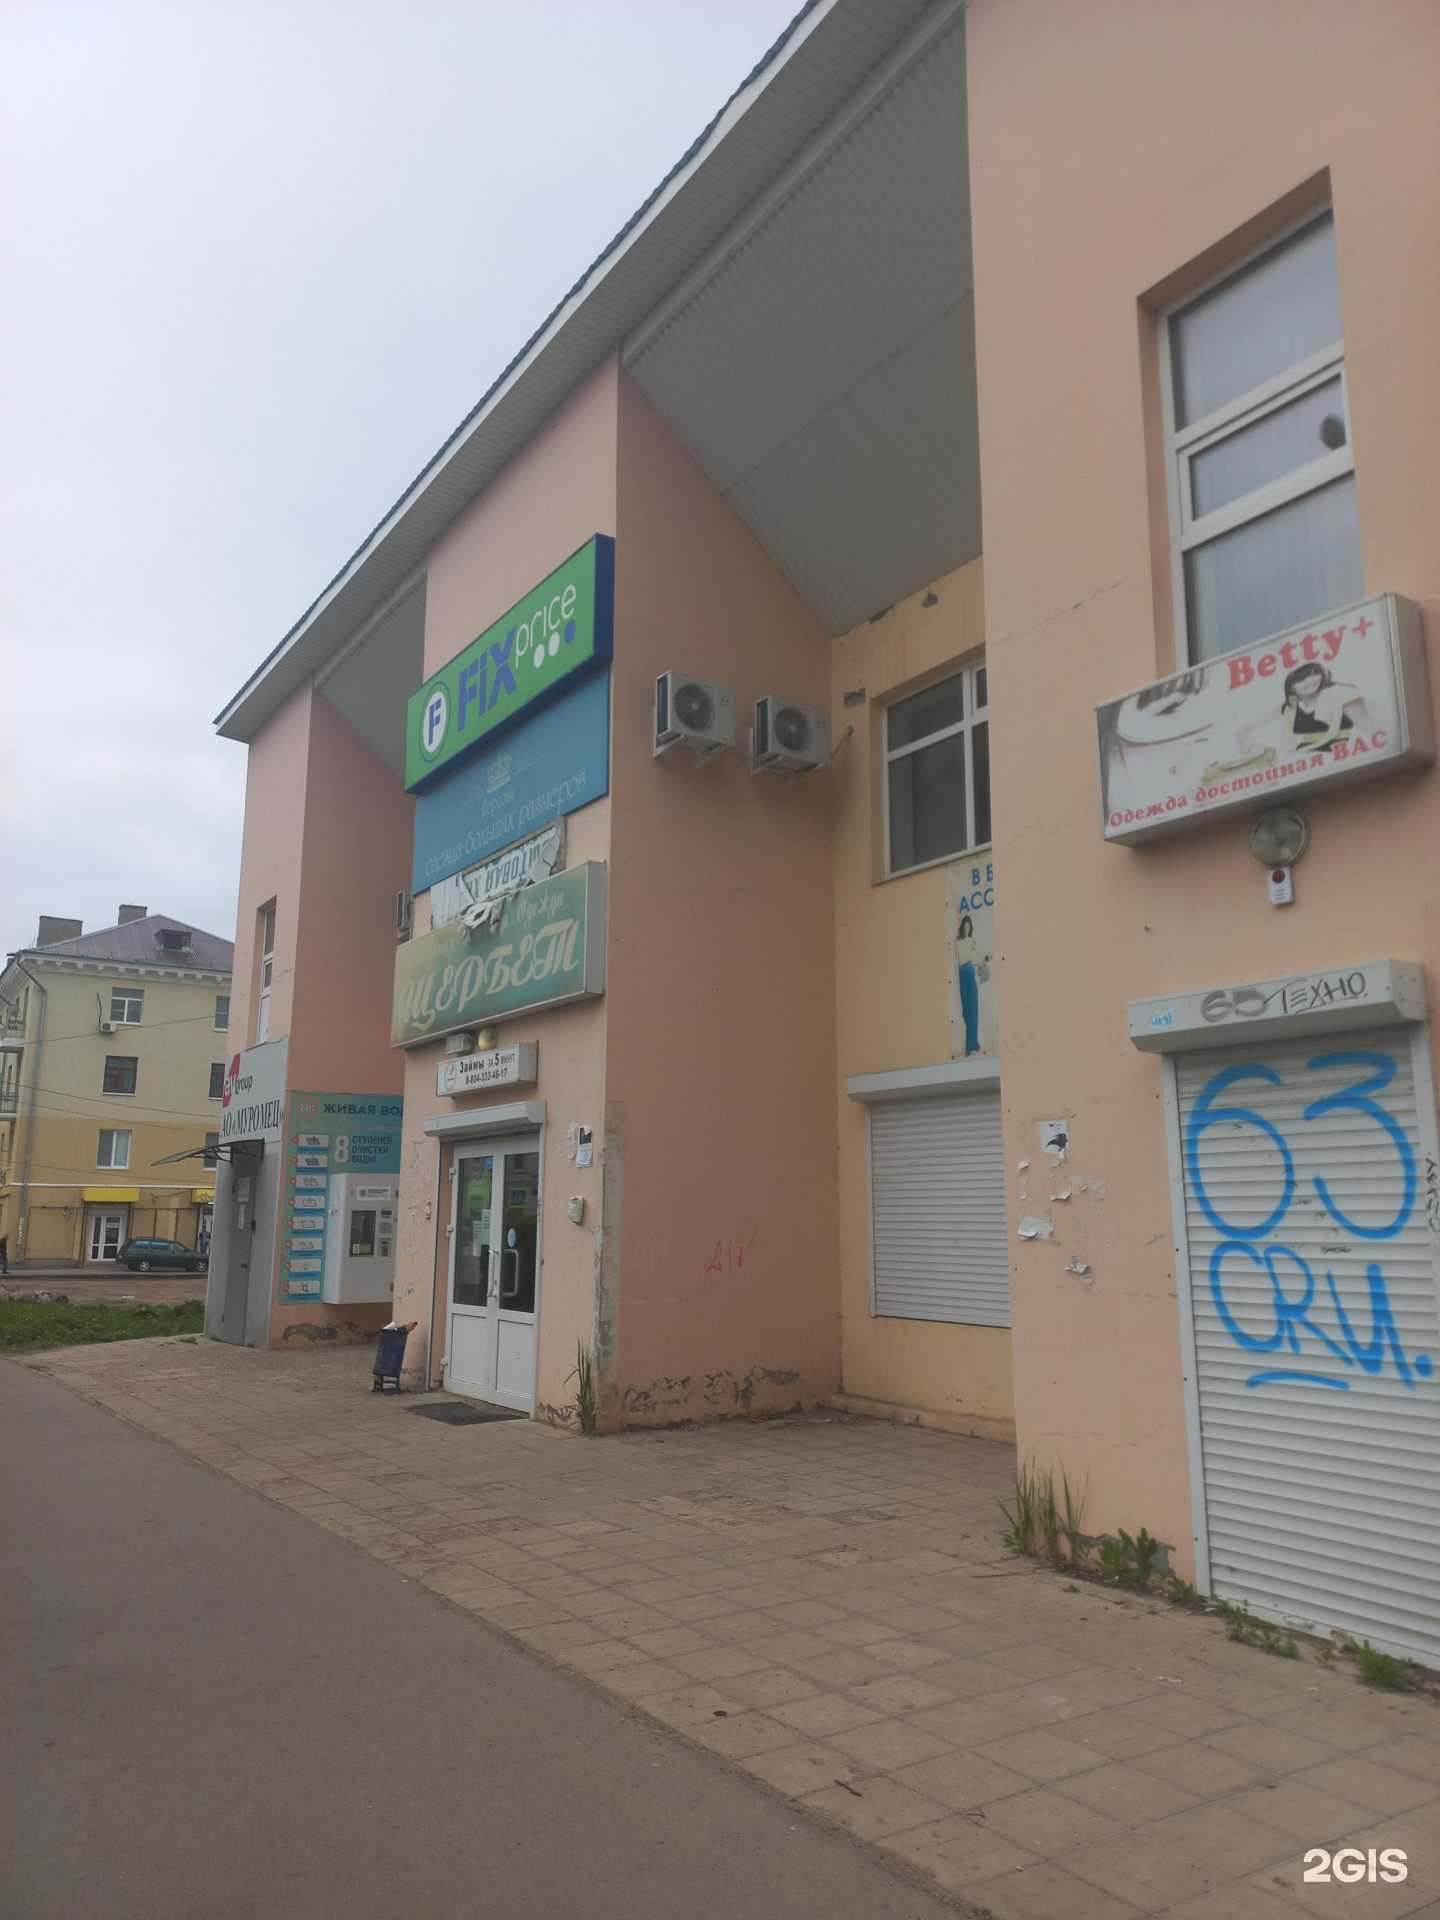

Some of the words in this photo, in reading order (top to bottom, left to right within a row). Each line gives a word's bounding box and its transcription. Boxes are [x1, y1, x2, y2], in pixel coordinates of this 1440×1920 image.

[1109, 793, 1189, 828] Одежда
[1330, 729, 1389, 762] ВАС
[459, 1059, 485, 1074] Займы
[322, 1103, 377, 1115] ЖИВАЯ
